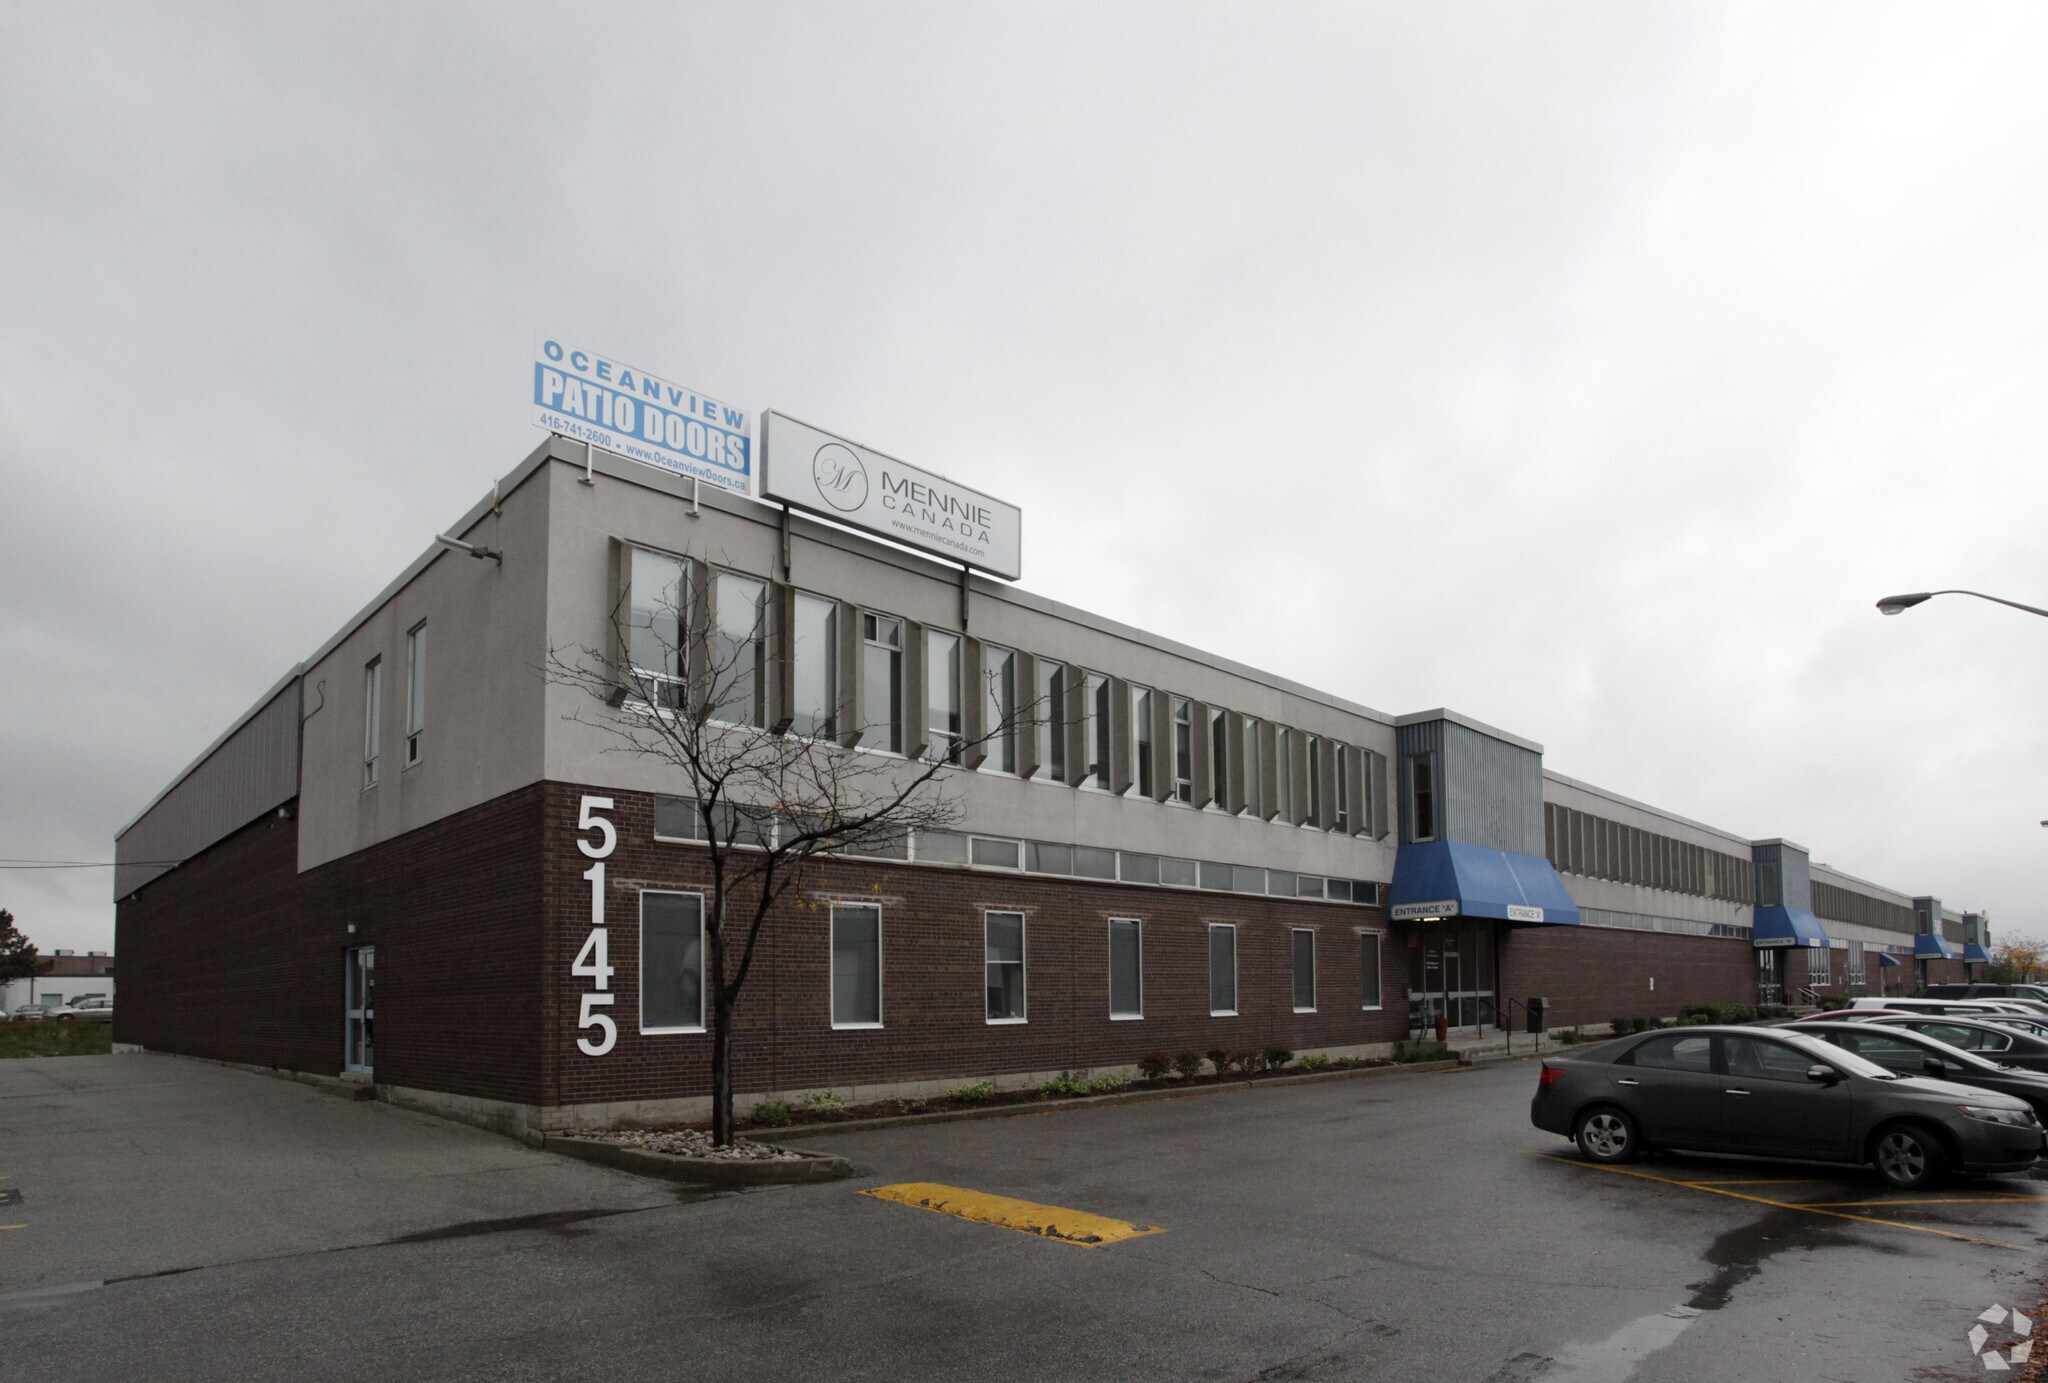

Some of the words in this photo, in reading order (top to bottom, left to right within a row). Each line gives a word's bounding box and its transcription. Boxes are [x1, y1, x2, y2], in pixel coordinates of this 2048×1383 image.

[543, 340, 745, 430] OCEANVIEW
[542, 367, 636, 433] PATIO
[643, 403, 746, 470] DOORS
[540, 413, 611, 447] 416-741-2600
[626, 444, 746, 491] www.OceanviewDoors.ca
[882, 471, 992, 529] MENNIE
[882, 495, 990, 544] CANADA
[891, 519, 985, 558] www.menniecanada.com
[1394, 905, 1440, 916] ENTRANCE
[1442, 903, 1455, 912] "A"
[1509, 907, 1535, 919] ENTRANCE
